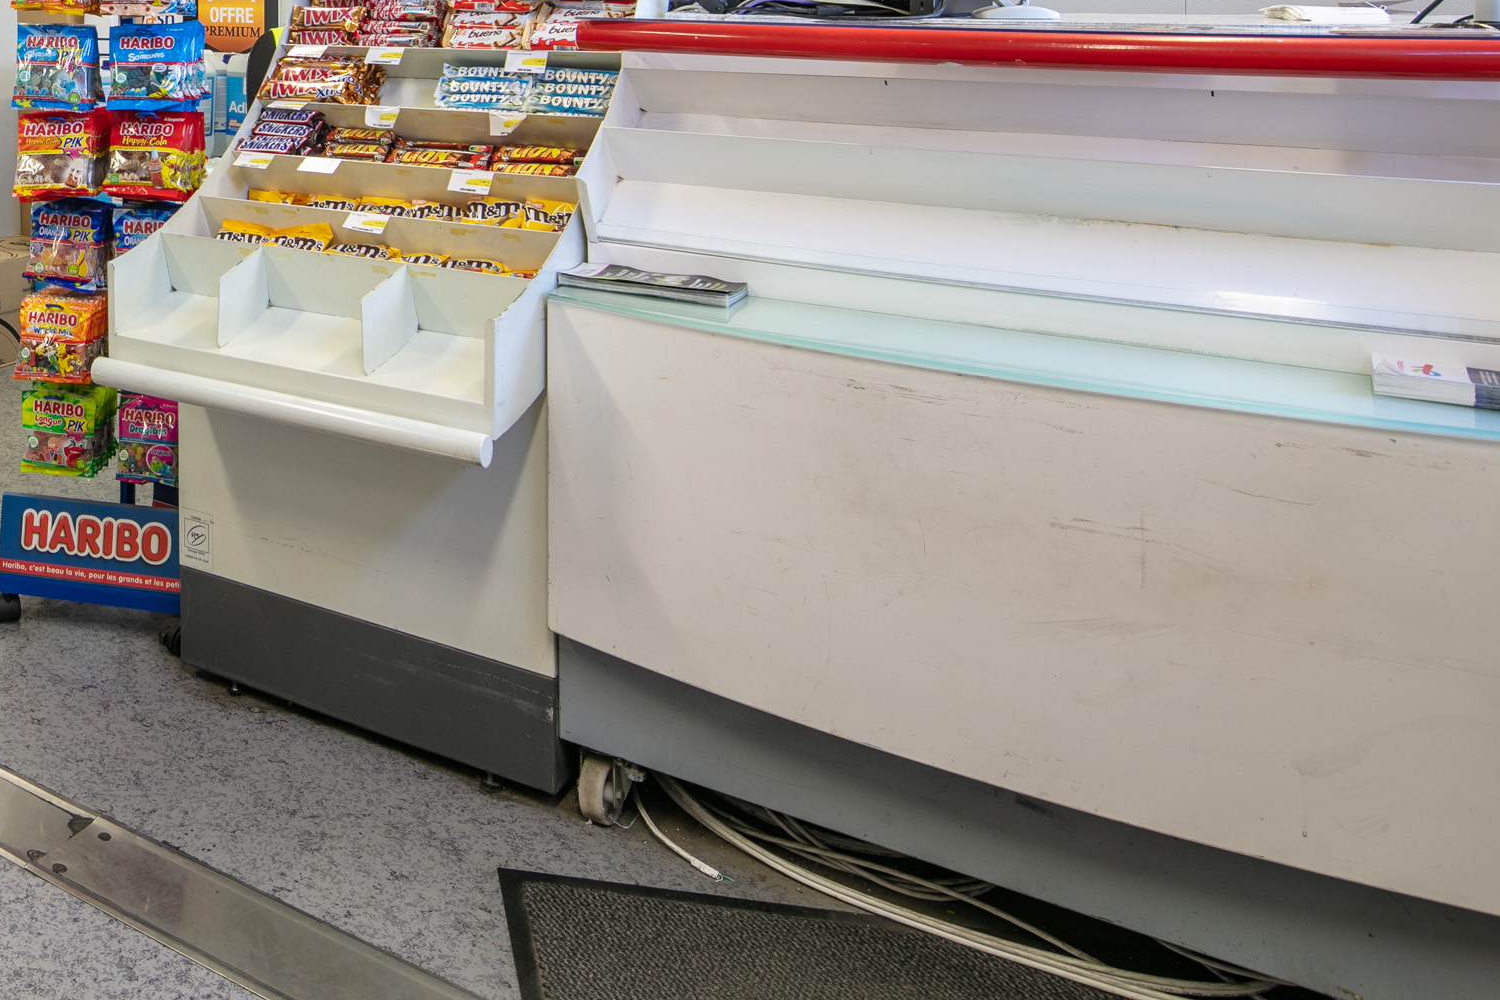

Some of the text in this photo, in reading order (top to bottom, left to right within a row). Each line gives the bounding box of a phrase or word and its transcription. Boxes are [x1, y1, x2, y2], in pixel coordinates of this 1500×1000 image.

[210, 6, 254, 24] OFFRE
[205, 26, 261, 38] PREMIUM
[120, 37, 175, 50] HARIBO
[545, 69, 609, 84] BOUNTY
[450, 80, 509, 94] BOUNTY
[261, 109, 313, 122] SNICKERS
[24, 122, 84, 137] HARIBO
[258, 123, 310, 137] SNICKERS
[511, 146, 562, 160] LION
[39, 212, 91, 229] HARIBO
[27, 311, 78, 327] HARIBO
[33, 399, 84, 418] HARIBO
[34, 414, 62, 427] Langue
[24, 511, 169, 562] HARIBO
[2, 561, 27, 572] Haribo,
[46, 565, 65, 575] beau
[66, 567, 73, 576] la
[74, 569, 87, 579] vie,
[88, 572, 106, 582] pour
[106, 573, 117, 581] les
[118, 575, 143, 586] grands
[144, 577, 152, 585] et
[153, 579, 165, 587] les
